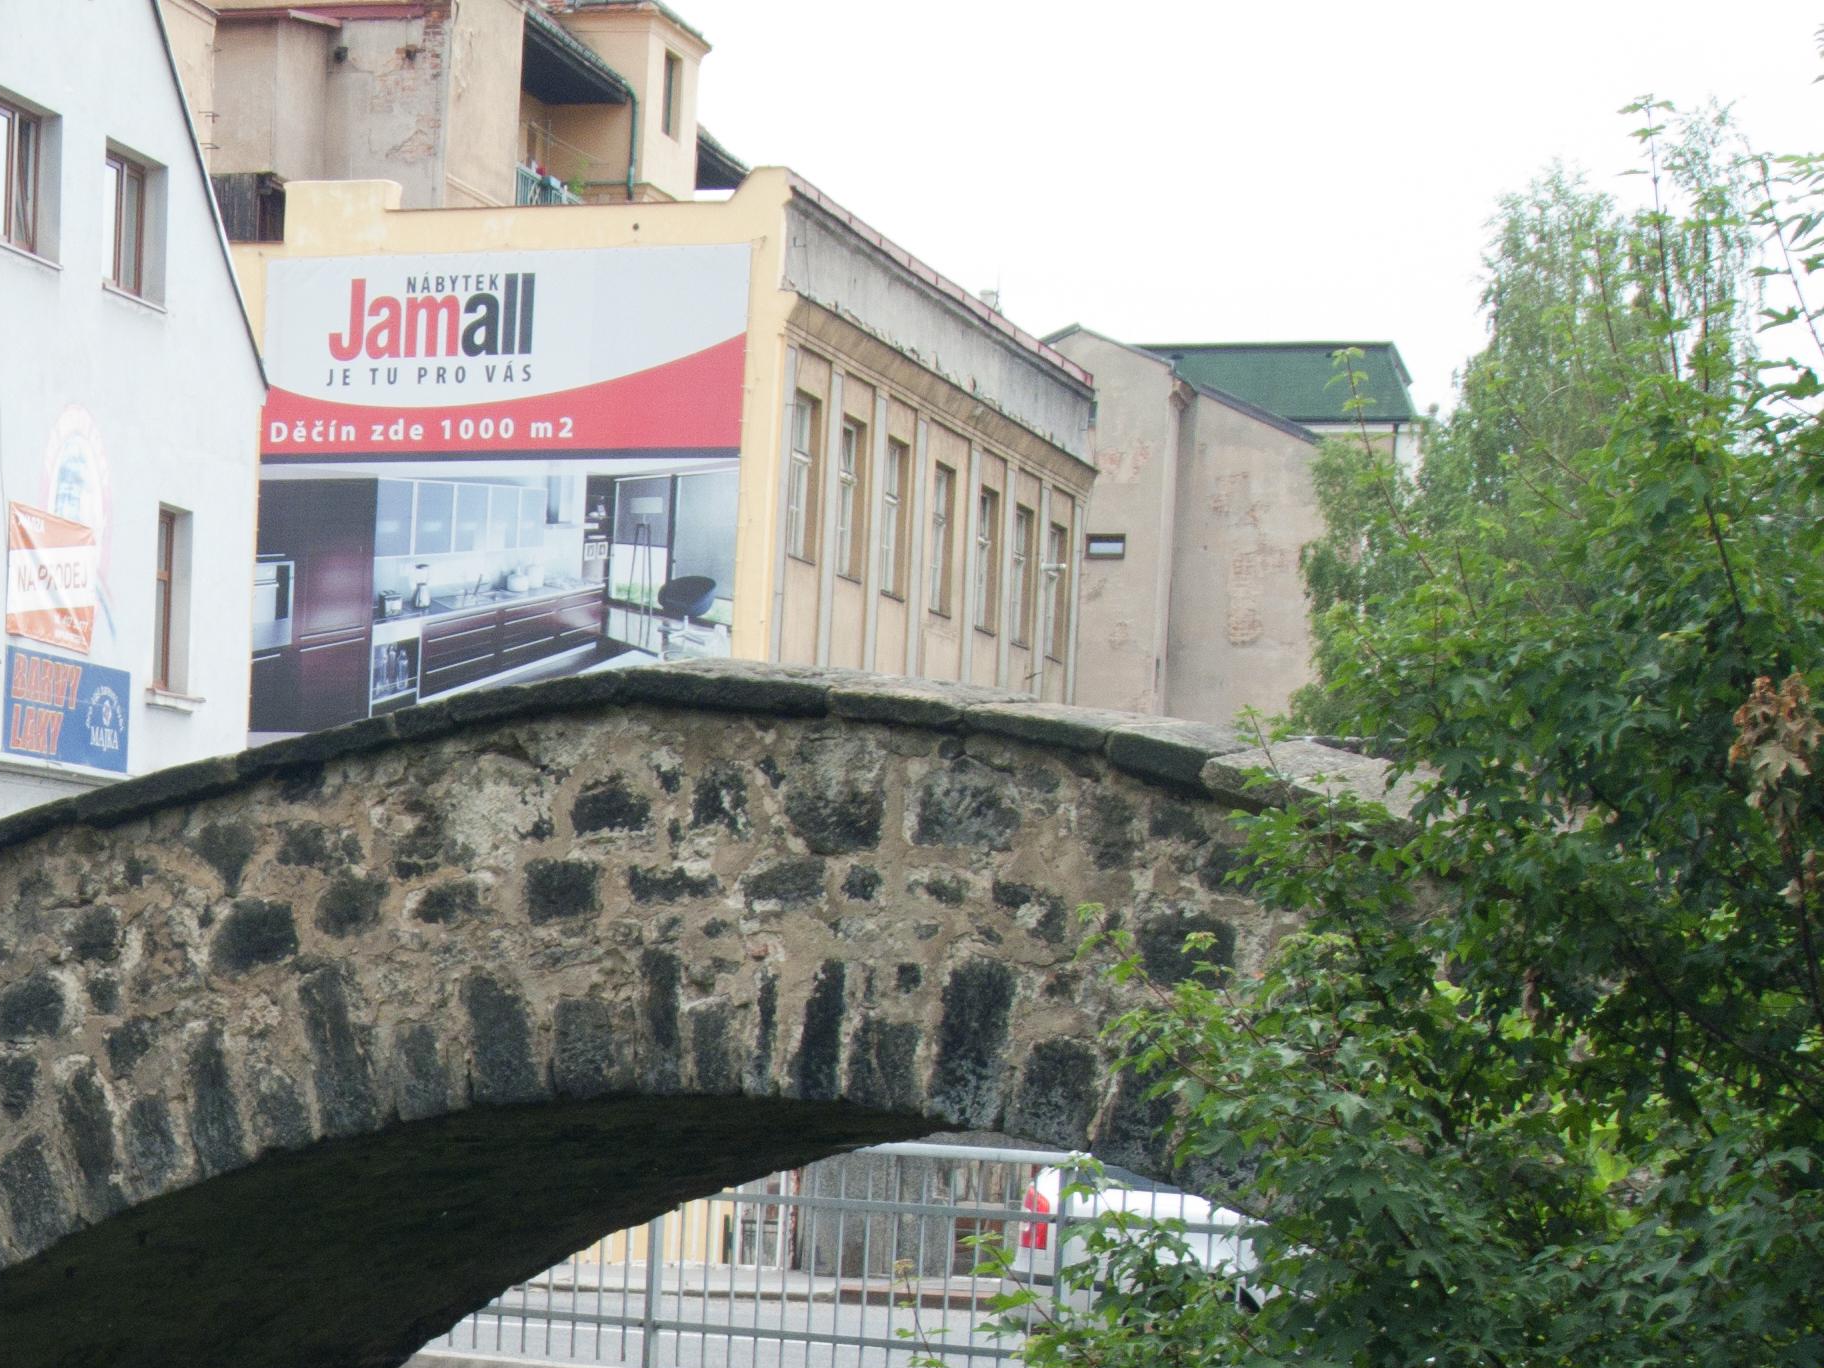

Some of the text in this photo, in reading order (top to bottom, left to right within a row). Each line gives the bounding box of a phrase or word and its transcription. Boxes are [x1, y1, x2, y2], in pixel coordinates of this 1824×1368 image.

[406, 272, 499, 294] NÁBYTEK
[328, 272, 536, 362] Jamall
[326, 361, 532, 386] JE TU PRO VÁS
[269, 416, 574, 443] Děčín zde 1000 m2
[9, 703, 65, 755] LAKY
